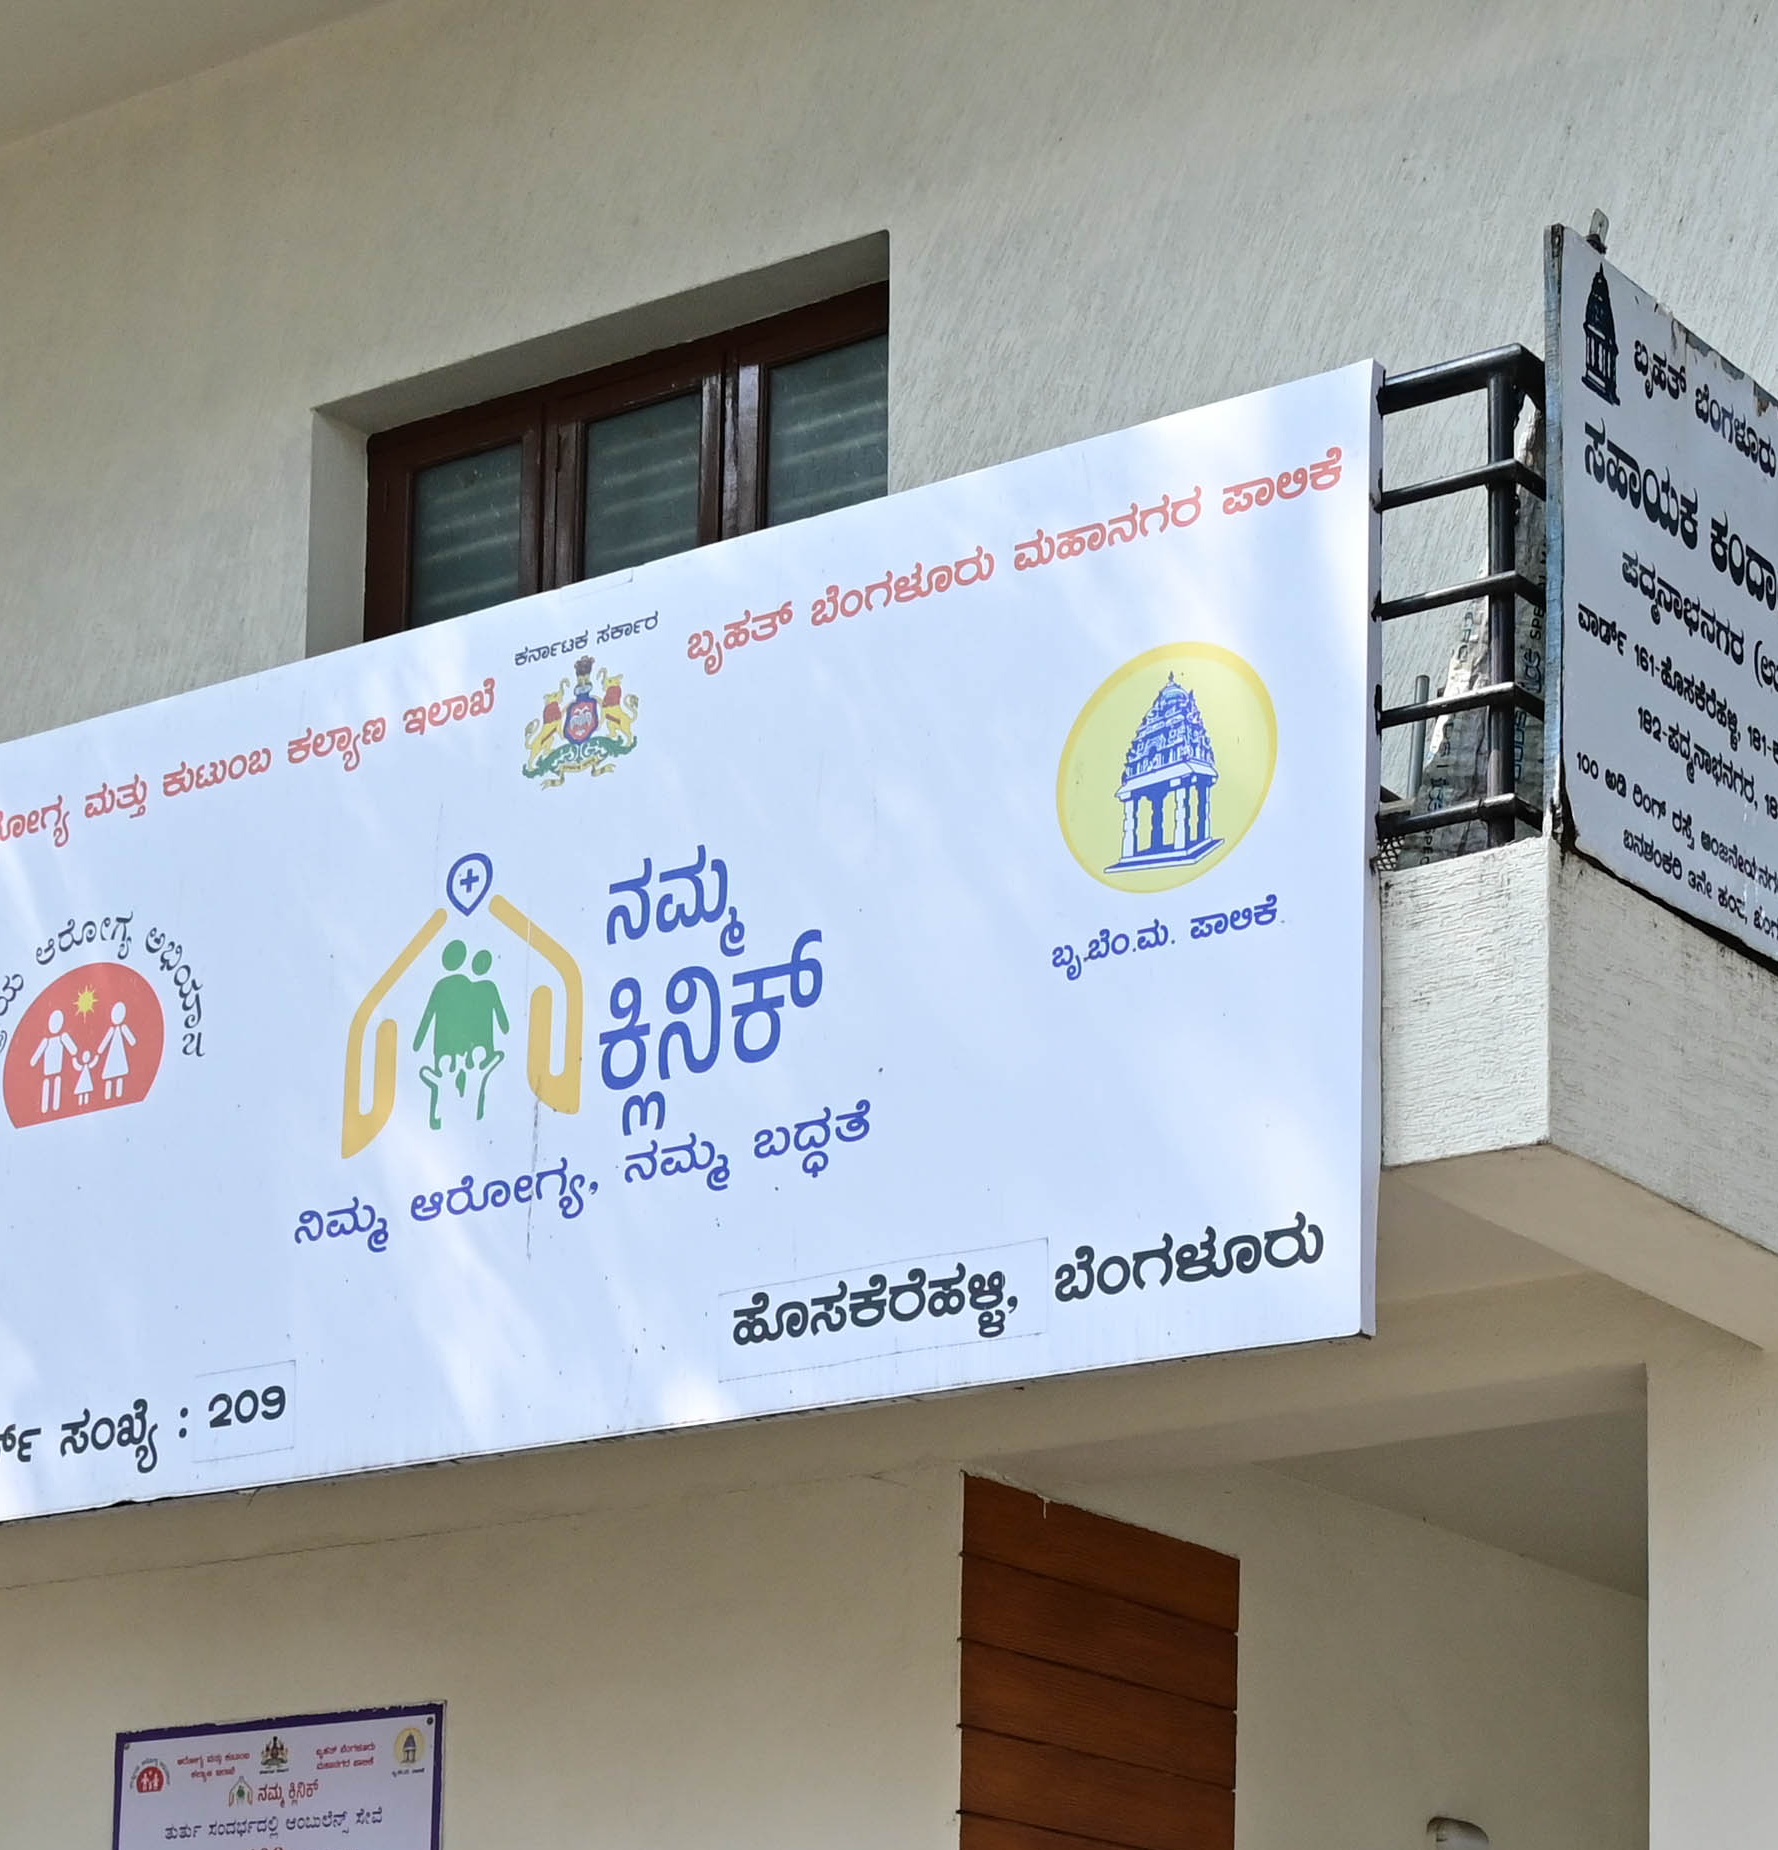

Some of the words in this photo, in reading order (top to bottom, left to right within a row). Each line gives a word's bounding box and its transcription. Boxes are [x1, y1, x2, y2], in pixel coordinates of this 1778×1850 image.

[1634, 339, 1687, 399] ಬೃಹತ್
[1695, 384, 1776, 478] ಬೆಂಗಳೂರು
[1584, 417, 1698, 550] ಸಹಾಯಕ
[687, 601, 794, 676] ಬೃಹತ್
[810, 546, 995, 628] ಬೆಂಗಳೂರು
[1013, 486, 1202, 571] ಮಹಾನಗರ
[1223, 446, 1343, 515] ಪಾಲಿಕೆ
[1622, 550, 1745, 665] ಪದ್ಮನಾಭನಗರ
[514, 627, 590, 667] ಕರ್ನಾಟಕ
[596, 611, 660, 651] ಸರ್ಕಾರ
[1578, 602, 1627, 656] ವಾರ್ಡ್
[84, 773, 148, 820] ಮತ್ತು
[162, 744, 271, 798] ಕುಟುಂಬ
[287, 716, 387, 773] ಕಲ್ಯಾಣ
[402, 677, 496, 735] ಇಲಾಖೆ
[1576, 752, 1600, 780] 100
[1632, 783, 1667, 820] ರಿಂಗ್
[36, 911, 133, 966] ಆರೋಗ್ಯ
[606, 844, 746, 957] ನಮ್ಮ
[599, 928, 823, 1136] ಕ್ಲಿನಿಕ್
[294, 1196, 389, 1253] ನಿಮ್ಮ
[410, 1158, 600, 1220] ಆರೋಗ್ಯ,
[624, 1132, 730, 1191] ನಮ್ಮ
[753, 1098, 872, 1178] ಬದ್ಧತೆ
[1054, 1211, 1324, 1304] ಬೆಂಗಳೂರು
[60, 1398, 158, 1473] ಸಂಖ್ಯೆ
[208, 1385, 286, 1428] 209
[258, 1783, 285, 1808] ನಮ್ಮ
[288, 1778, 319, 1806] ಕ್ಲಿನಿಕ್
